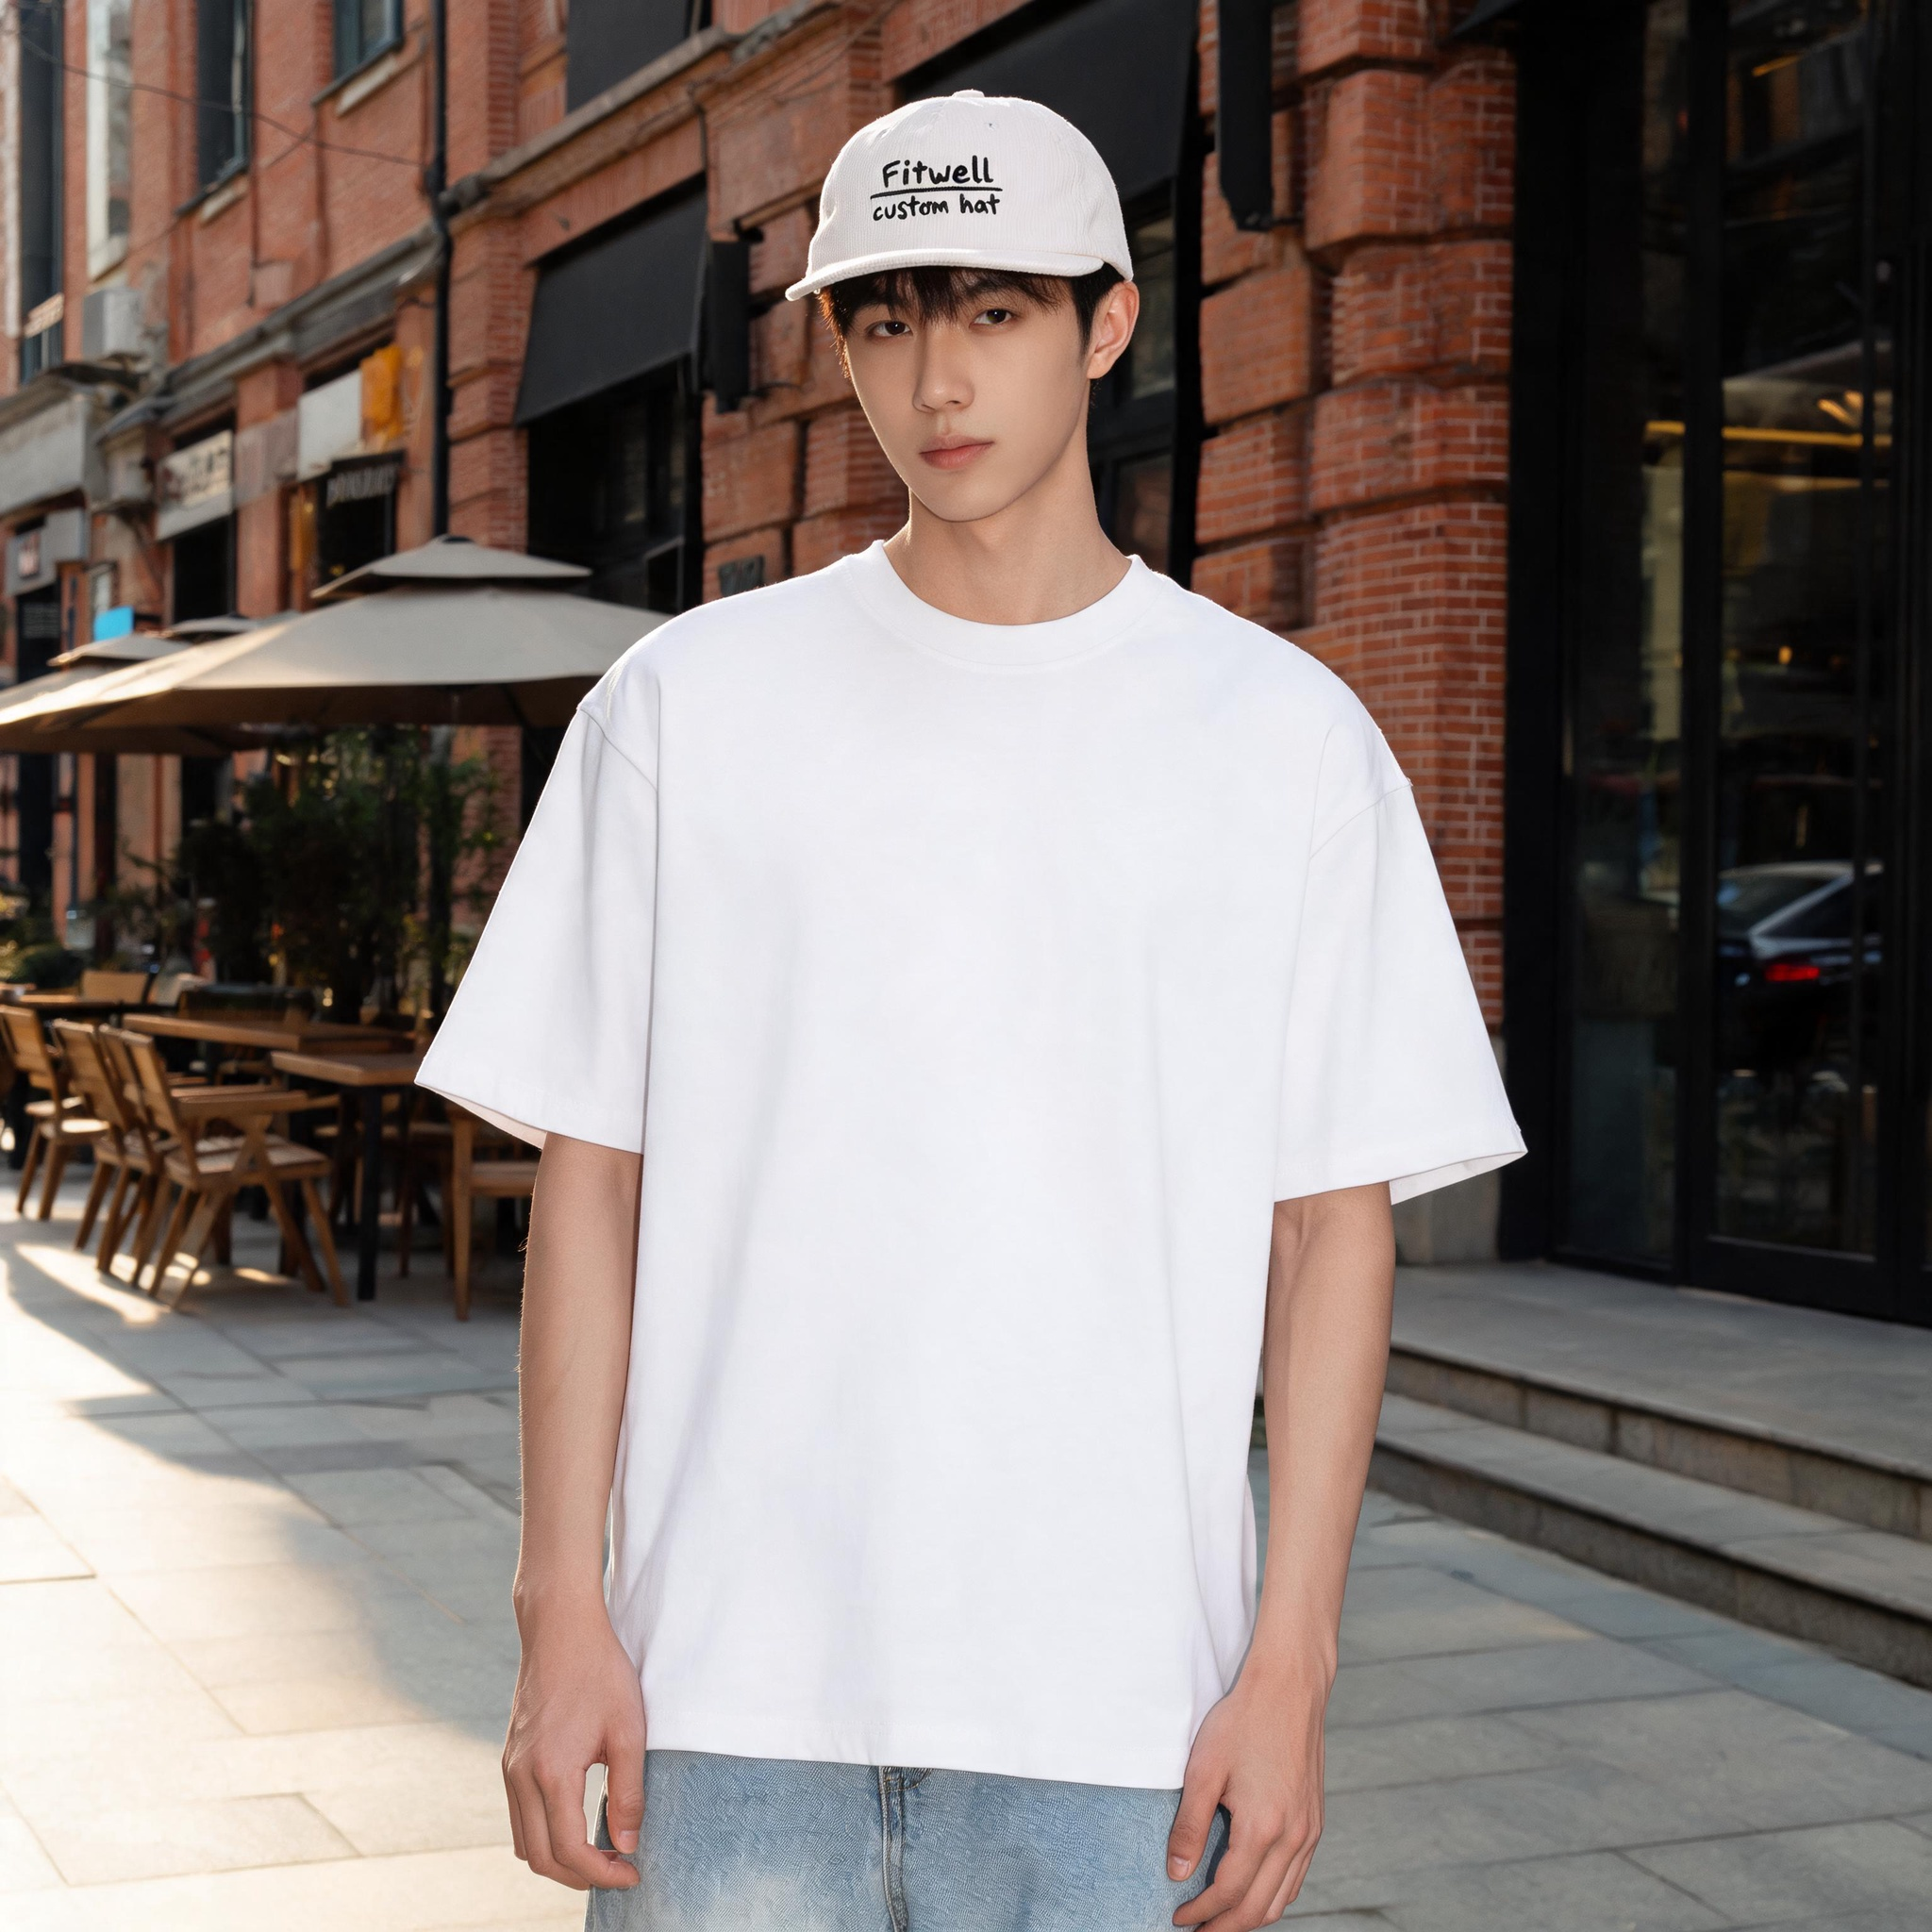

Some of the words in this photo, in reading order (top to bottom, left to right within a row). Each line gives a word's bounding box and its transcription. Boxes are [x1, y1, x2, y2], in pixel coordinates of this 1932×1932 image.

[882, 155, 993, 188] Fitwell
[873, 195, 949, 221] custom
[959, 193, 1000, 215] hat
